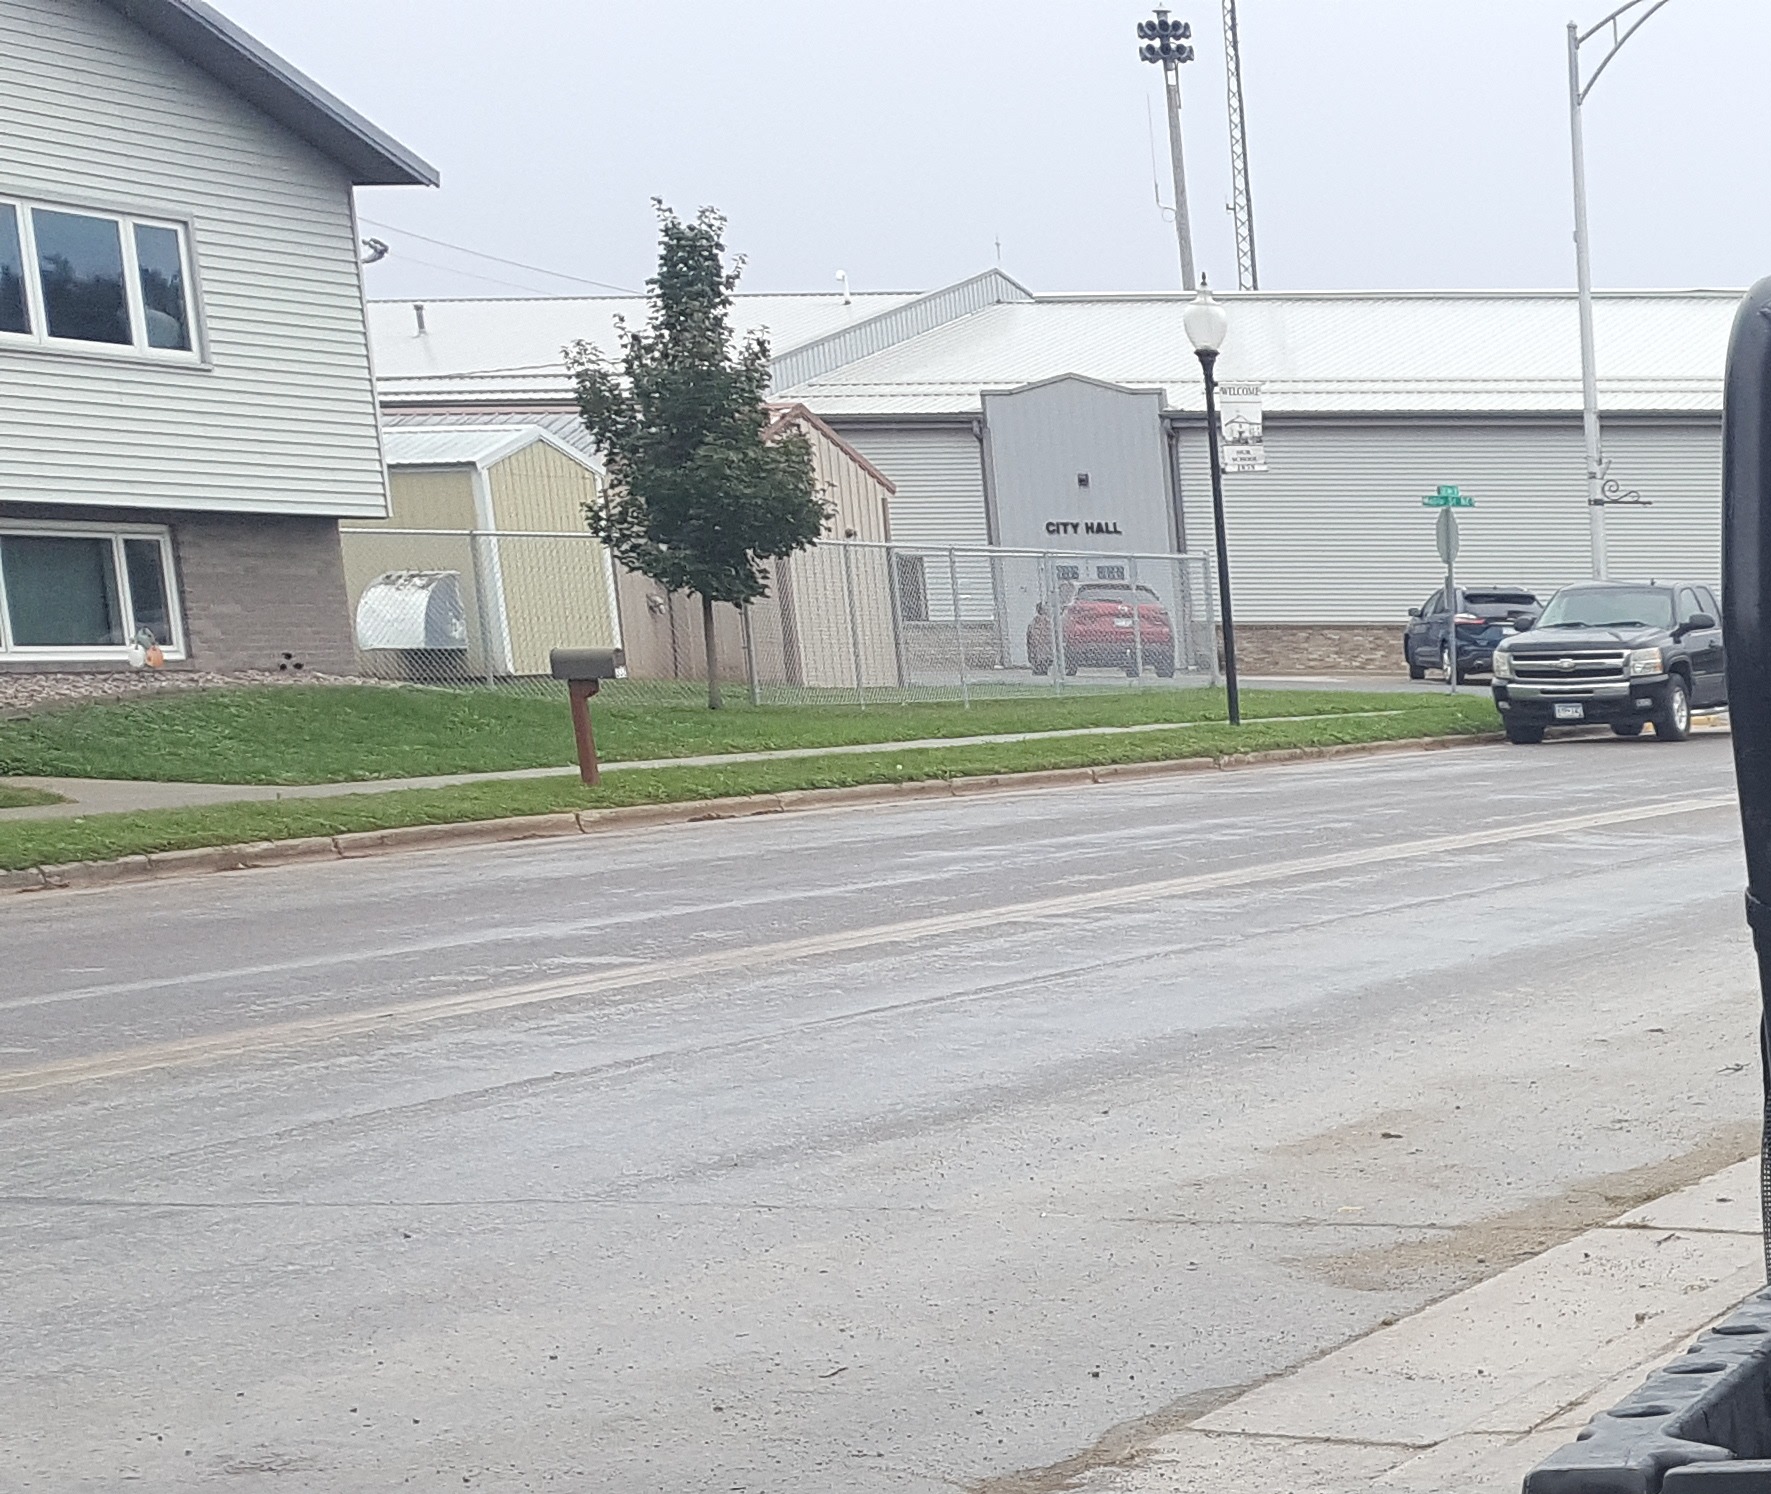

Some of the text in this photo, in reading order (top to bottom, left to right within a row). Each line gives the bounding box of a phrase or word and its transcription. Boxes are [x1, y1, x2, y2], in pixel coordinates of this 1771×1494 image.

[1220, 386, 1259, 396] WELCOME
[1045, 521, 1122, 535] CITY HALL
